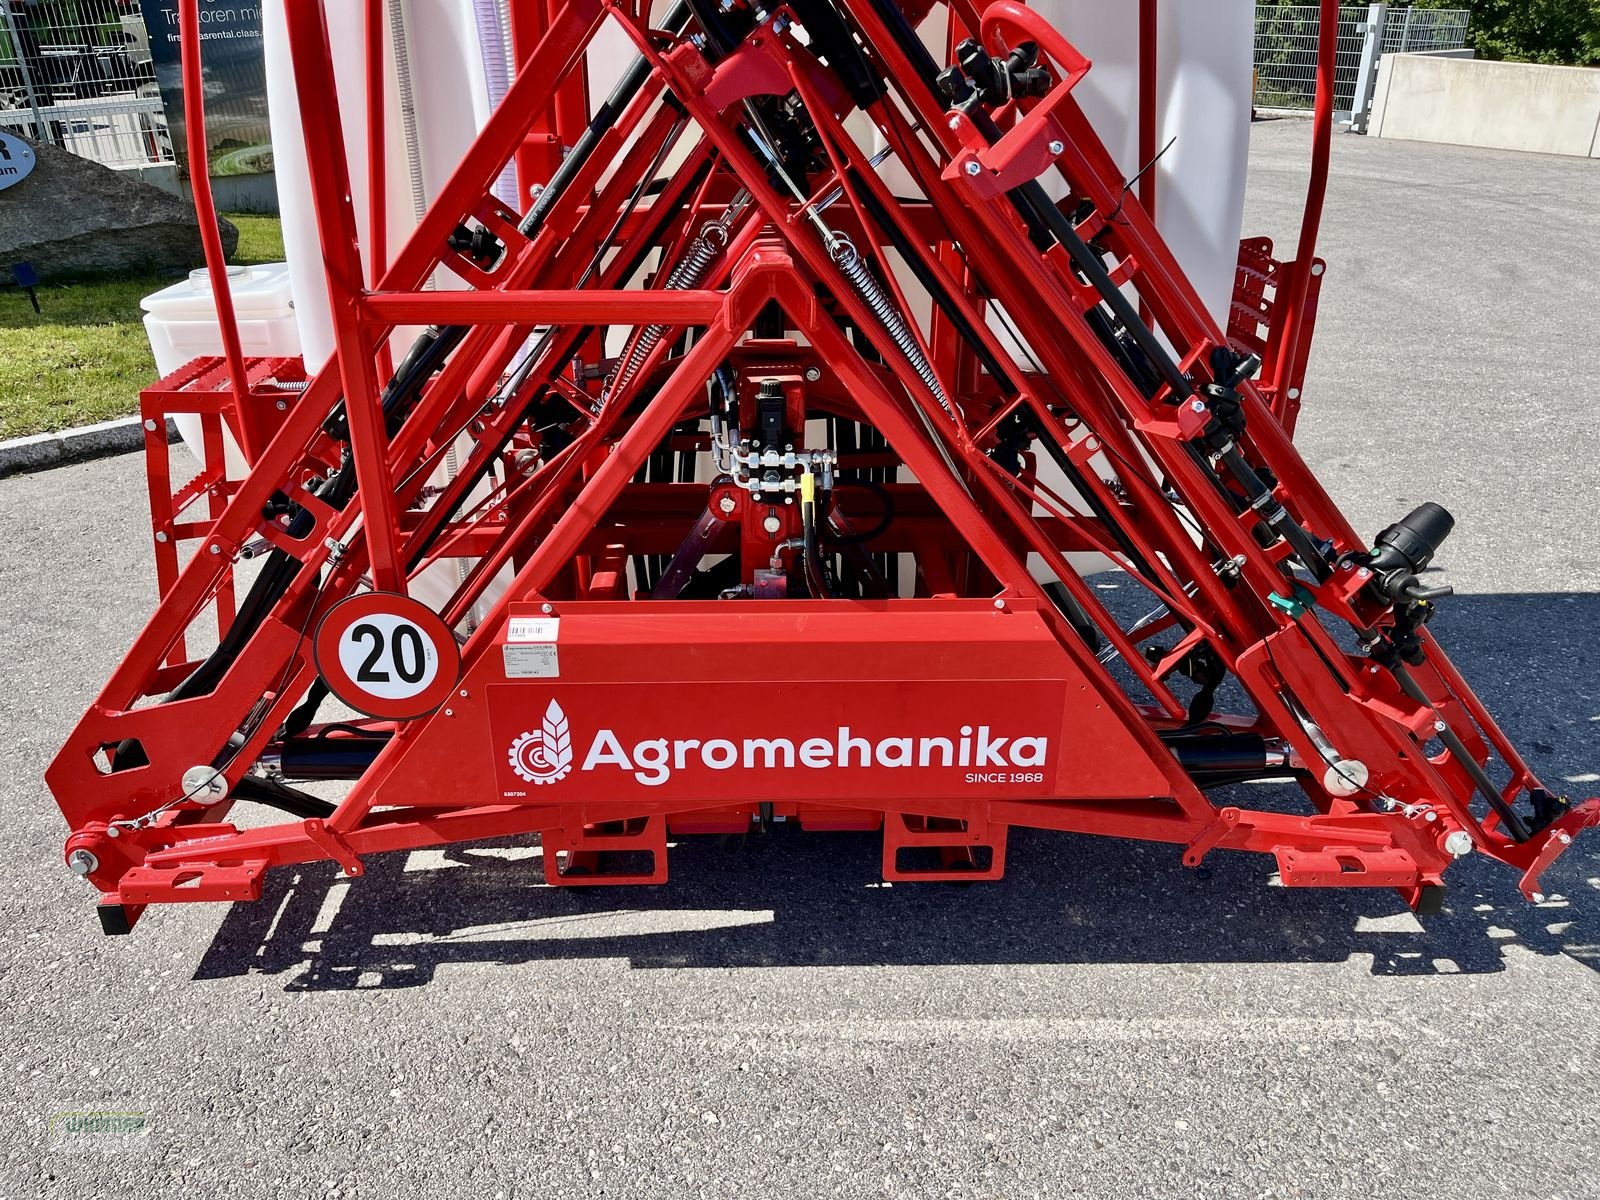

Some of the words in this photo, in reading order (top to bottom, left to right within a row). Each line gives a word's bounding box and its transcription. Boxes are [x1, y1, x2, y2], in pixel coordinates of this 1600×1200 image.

[351, 623, 426, 684] 20
[582, 726, 1047, 786] Agromehanika
[965, 773, 1007, 784] SINCE
[1009, 772, 1043, 783] 1968
